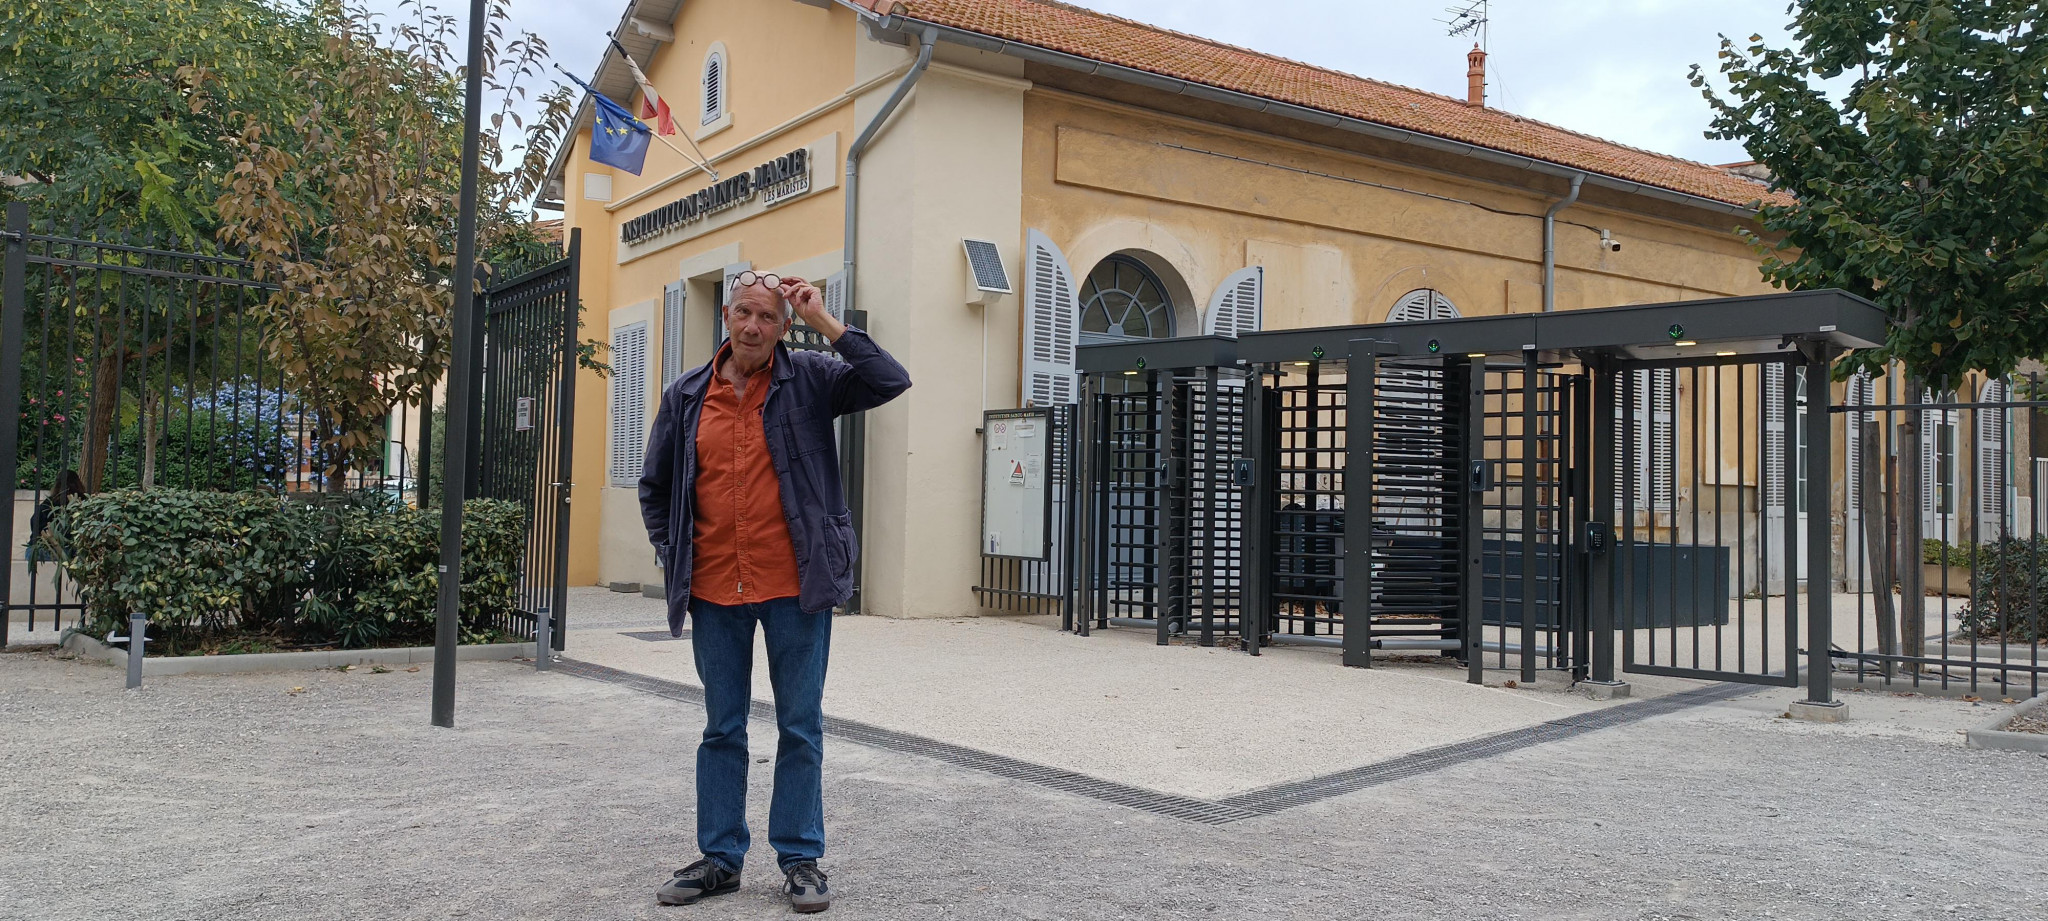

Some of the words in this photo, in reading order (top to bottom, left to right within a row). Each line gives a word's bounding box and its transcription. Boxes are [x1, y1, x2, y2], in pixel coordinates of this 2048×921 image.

[622, 193, 698, 243] INSTITUTION
[697, 148, 807, 213] SAINTE-MARIE
[763, 189, 775, 203] LES
[776, 177, 808, 198] MARISTES
